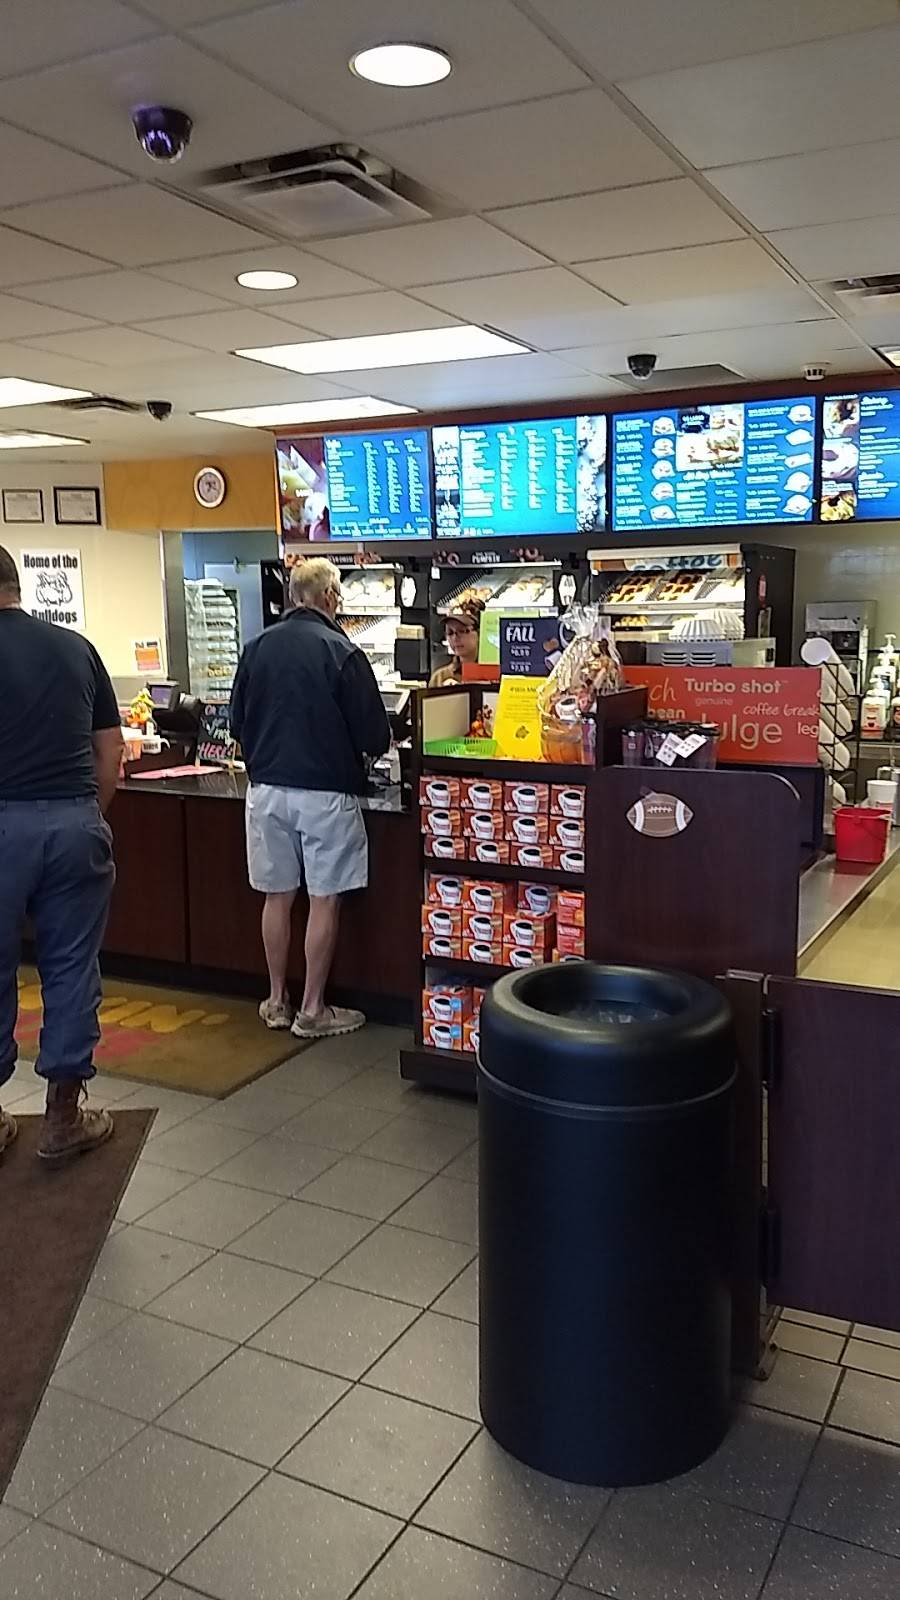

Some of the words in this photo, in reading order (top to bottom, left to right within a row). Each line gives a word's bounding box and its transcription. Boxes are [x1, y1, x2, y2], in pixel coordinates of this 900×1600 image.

[23, 554, 50, 568] Home
[51, 554, 61, 568] of
[62, 554, 78, 568] the
[505, 627, 536, 642] FALL
[684, 678, 736, 693] Turbo
[741, 679, 781, 693] shot
[743, 702, 780, 716] coffee
